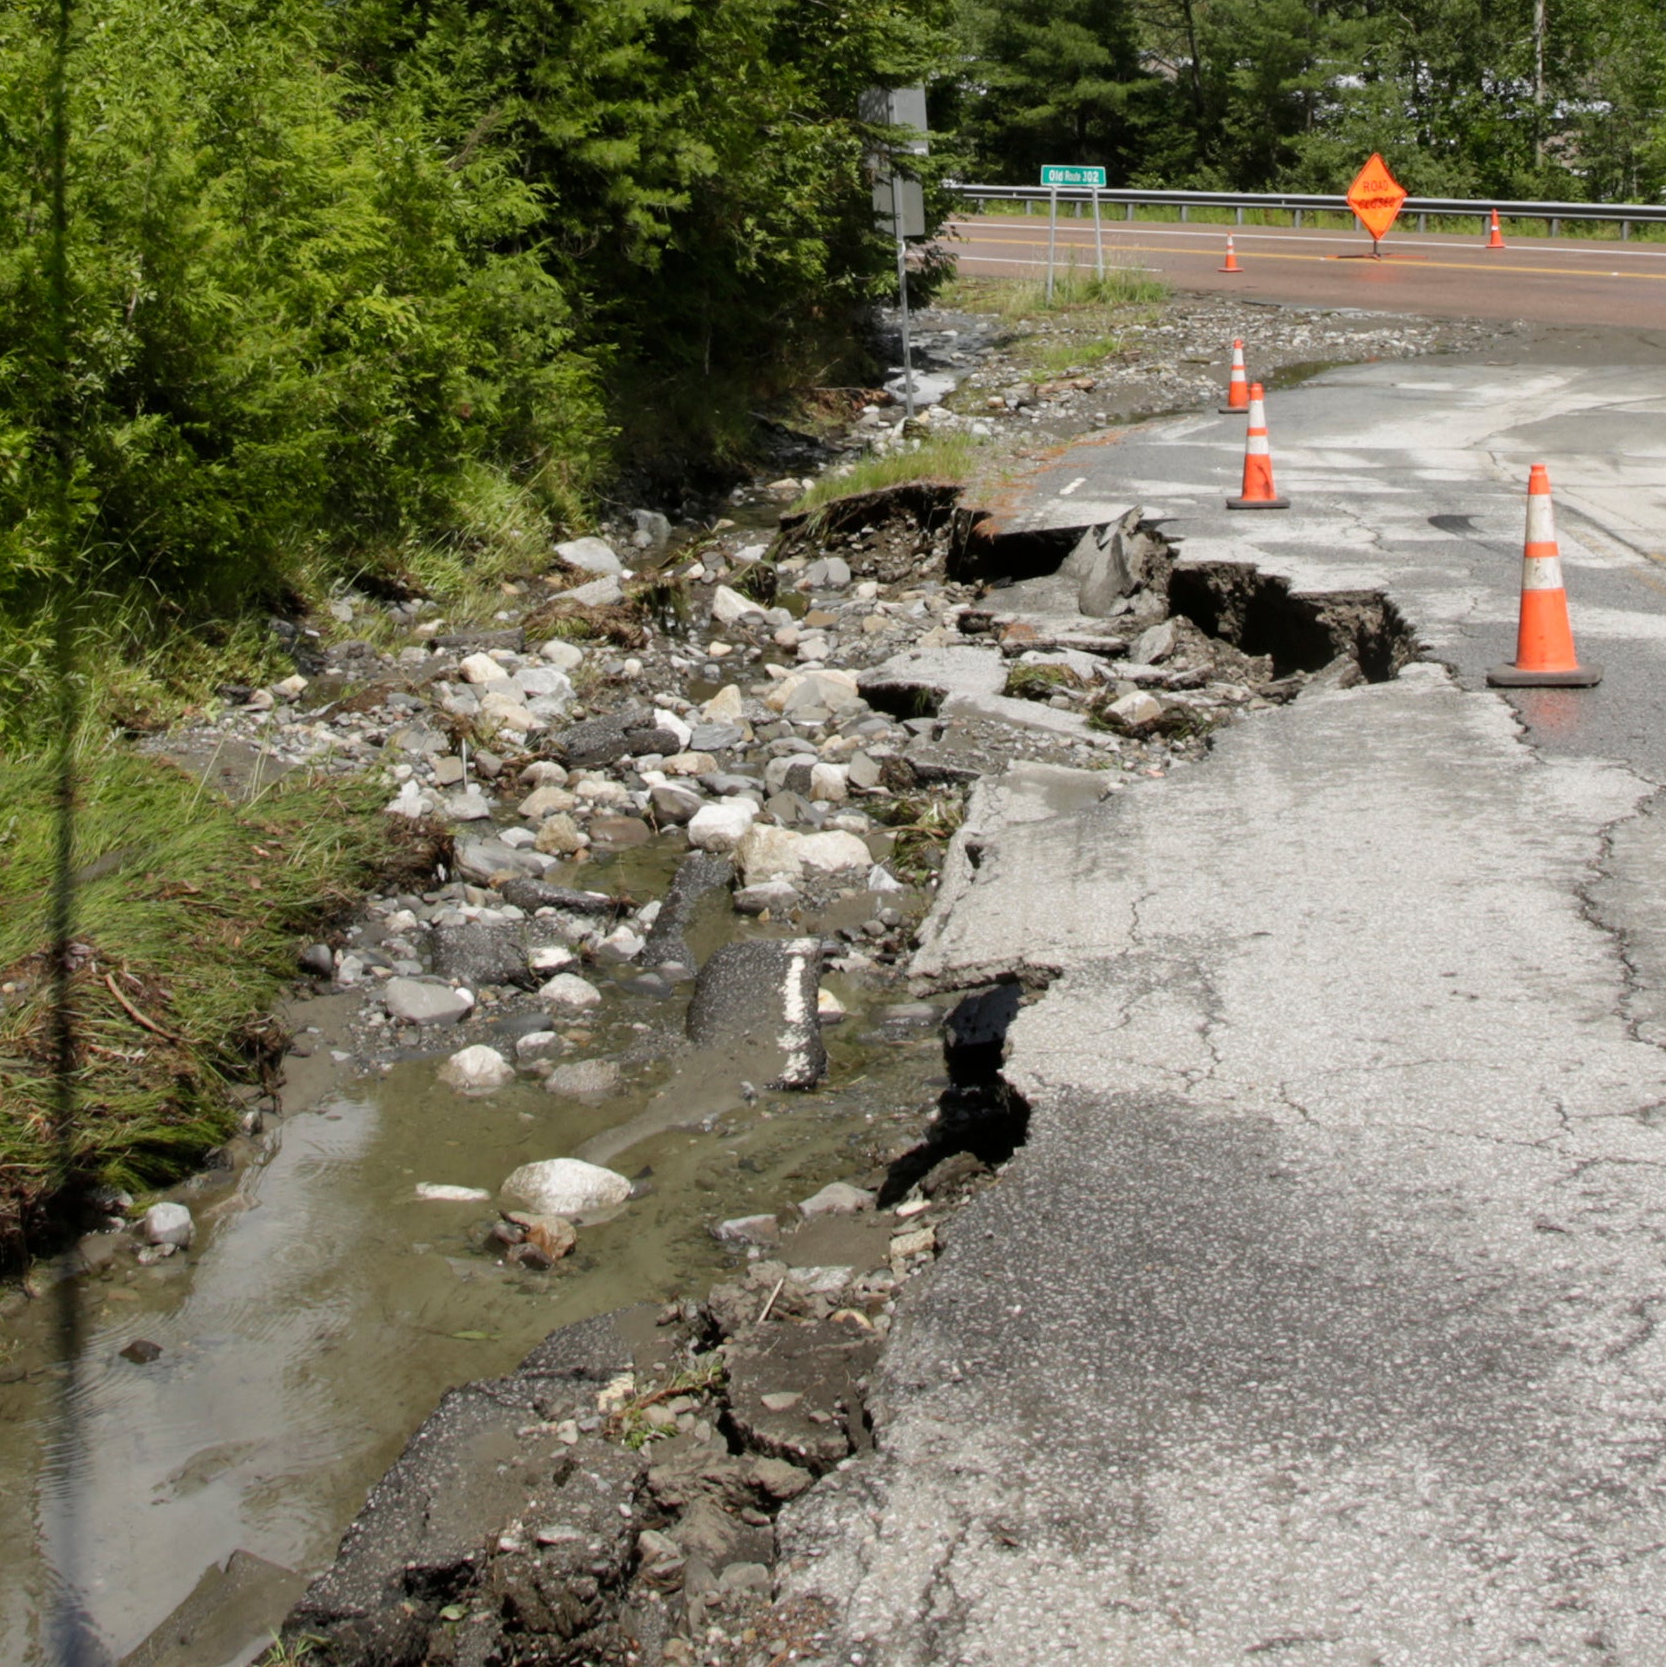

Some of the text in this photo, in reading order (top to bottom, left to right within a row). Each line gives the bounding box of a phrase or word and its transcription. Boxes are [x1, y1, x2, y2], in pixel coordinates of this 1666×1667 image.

[1048, 169, 1099, 183] Old Route 302
[1362, 179, 1389, 192] ROAD
[1358, 197, 1396, 210] CLOSED
